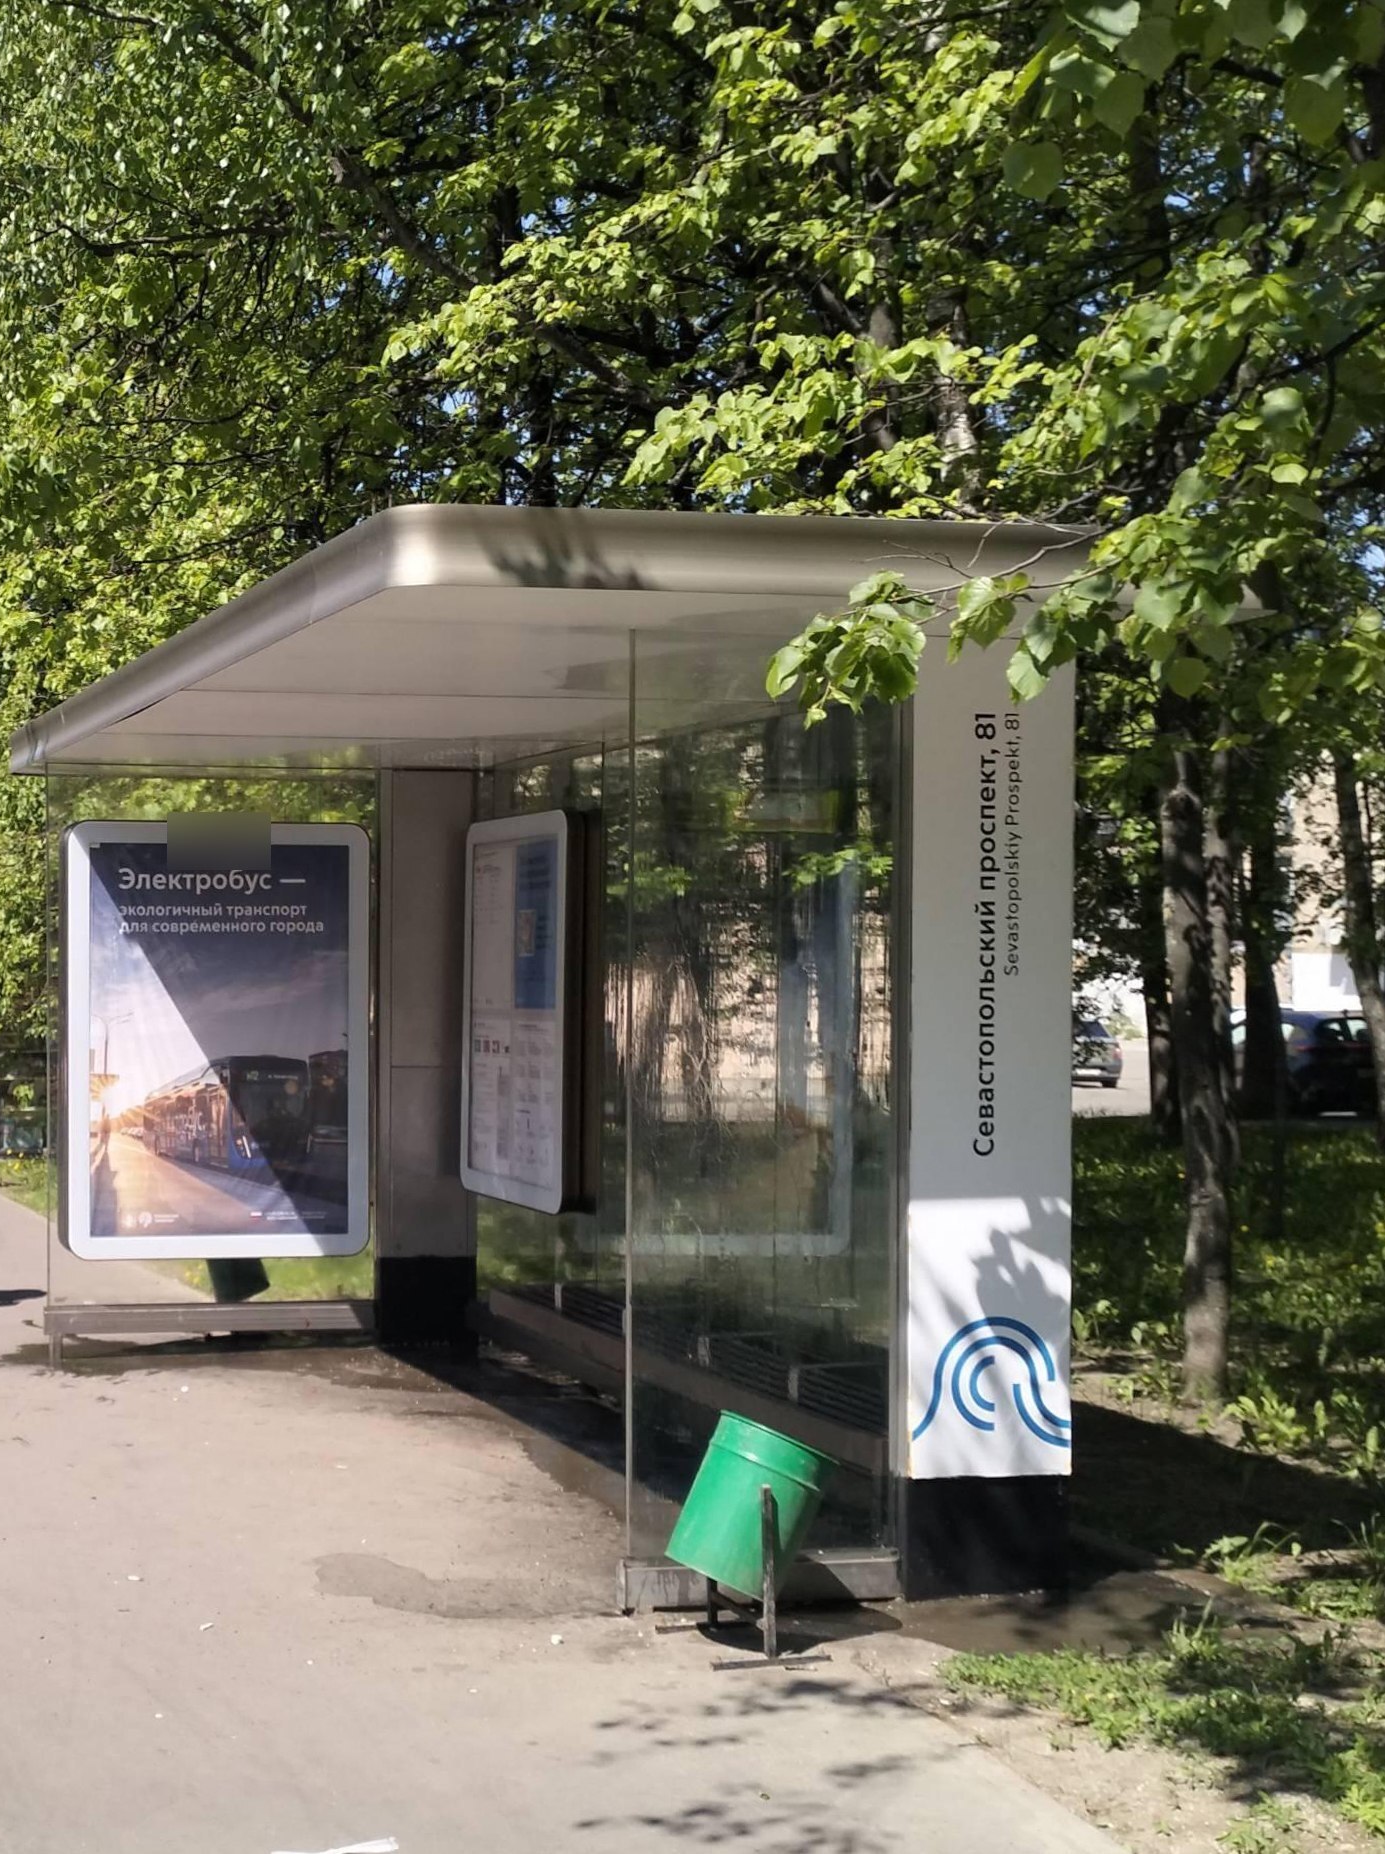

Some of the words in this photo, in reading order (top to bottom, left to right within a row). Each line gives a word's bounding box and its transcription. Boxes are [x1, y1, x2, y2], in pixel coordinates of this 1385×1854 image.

[974, 713, 996, 741] 81
[1004, 713, 1019, 731] 81
[1003, 735, 1022, 826] Prospekt,
[978, 748, 1001, 891] проспект,
[118, 867, 272, 895] Электробус
[119, 902, 223, 917] экологичный
[226, 904, 308, 920] транспорт
[1003, 831, 1023, 977] Sevastopolskiy
[118, 921, 148, 935] для
[151, 920, 266, 935] современного
[269, 920, 324, 934] города
[972, 899, 996, 1158] Севастопольский
